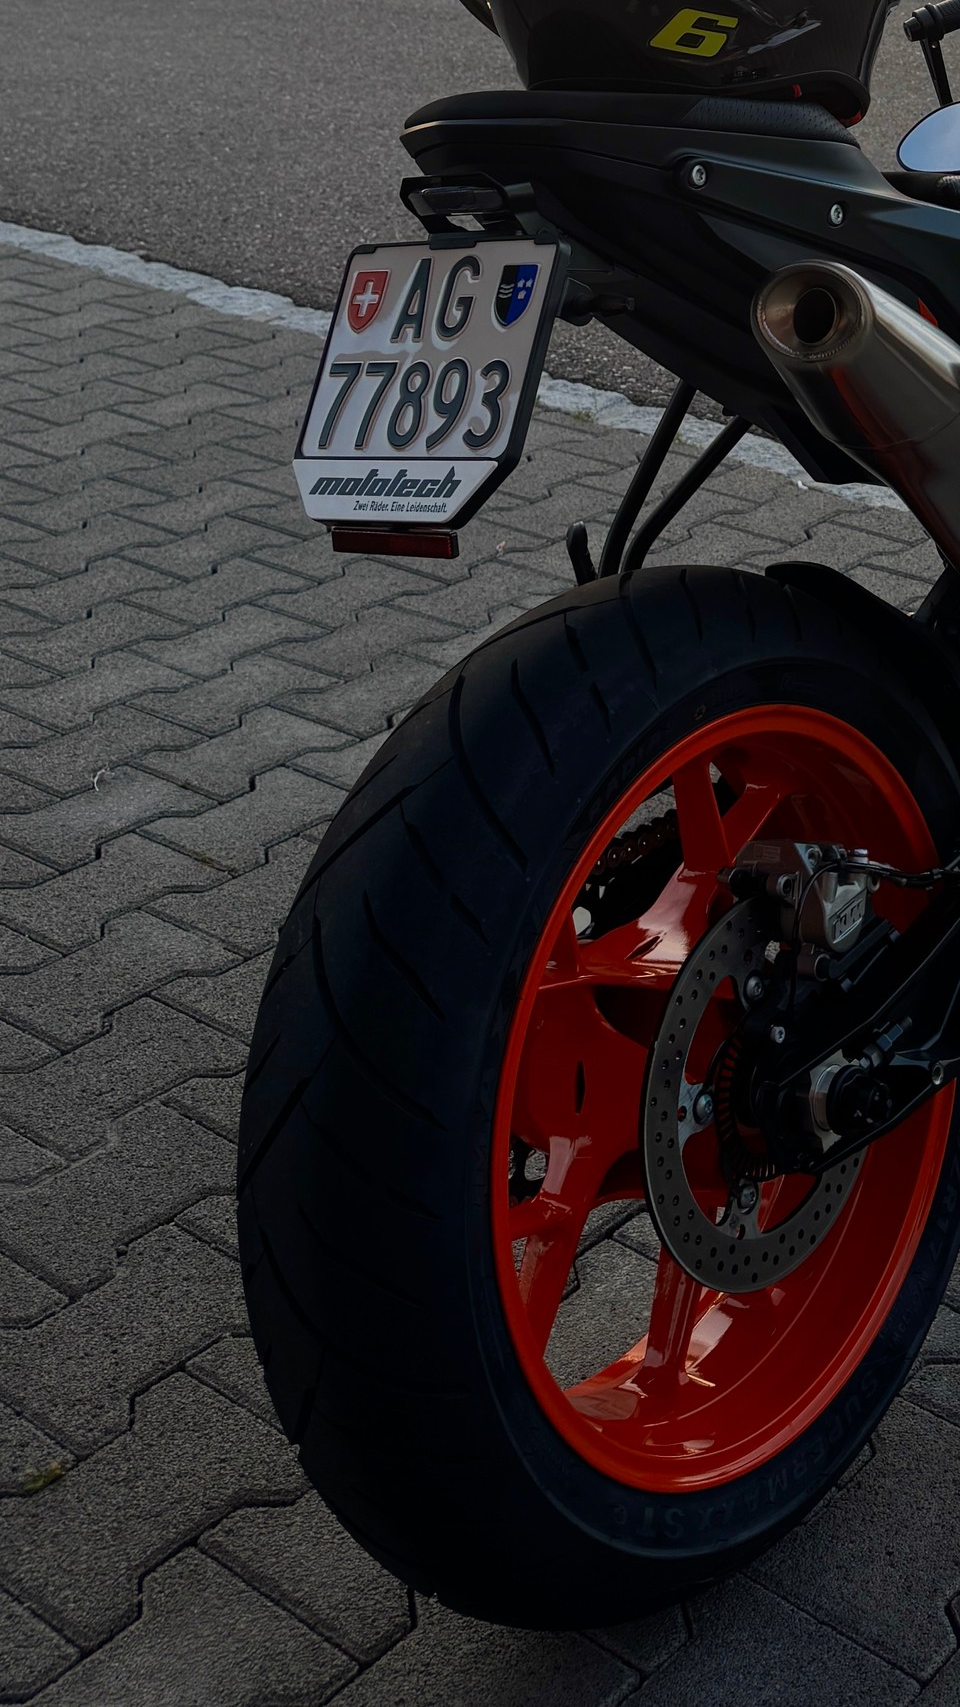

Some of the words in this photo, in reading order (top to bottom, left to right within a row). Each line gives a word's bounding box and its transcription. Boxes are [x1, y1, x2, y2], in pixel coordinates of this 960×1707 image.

[649, 8, 738, 57] 6
[390, 255, 482, 344] AG
[317, 358, 512, 452] 77893
[309, 466, 461, 498] mototech
[353, 501, 369, 511] Zwei
[370, 501, 389, 512] Räder.
[391, 501, 405, 512] Eine
[406, 501, 447, 513] Leidenschaft.
[832, 898, 864, 940] KTM
